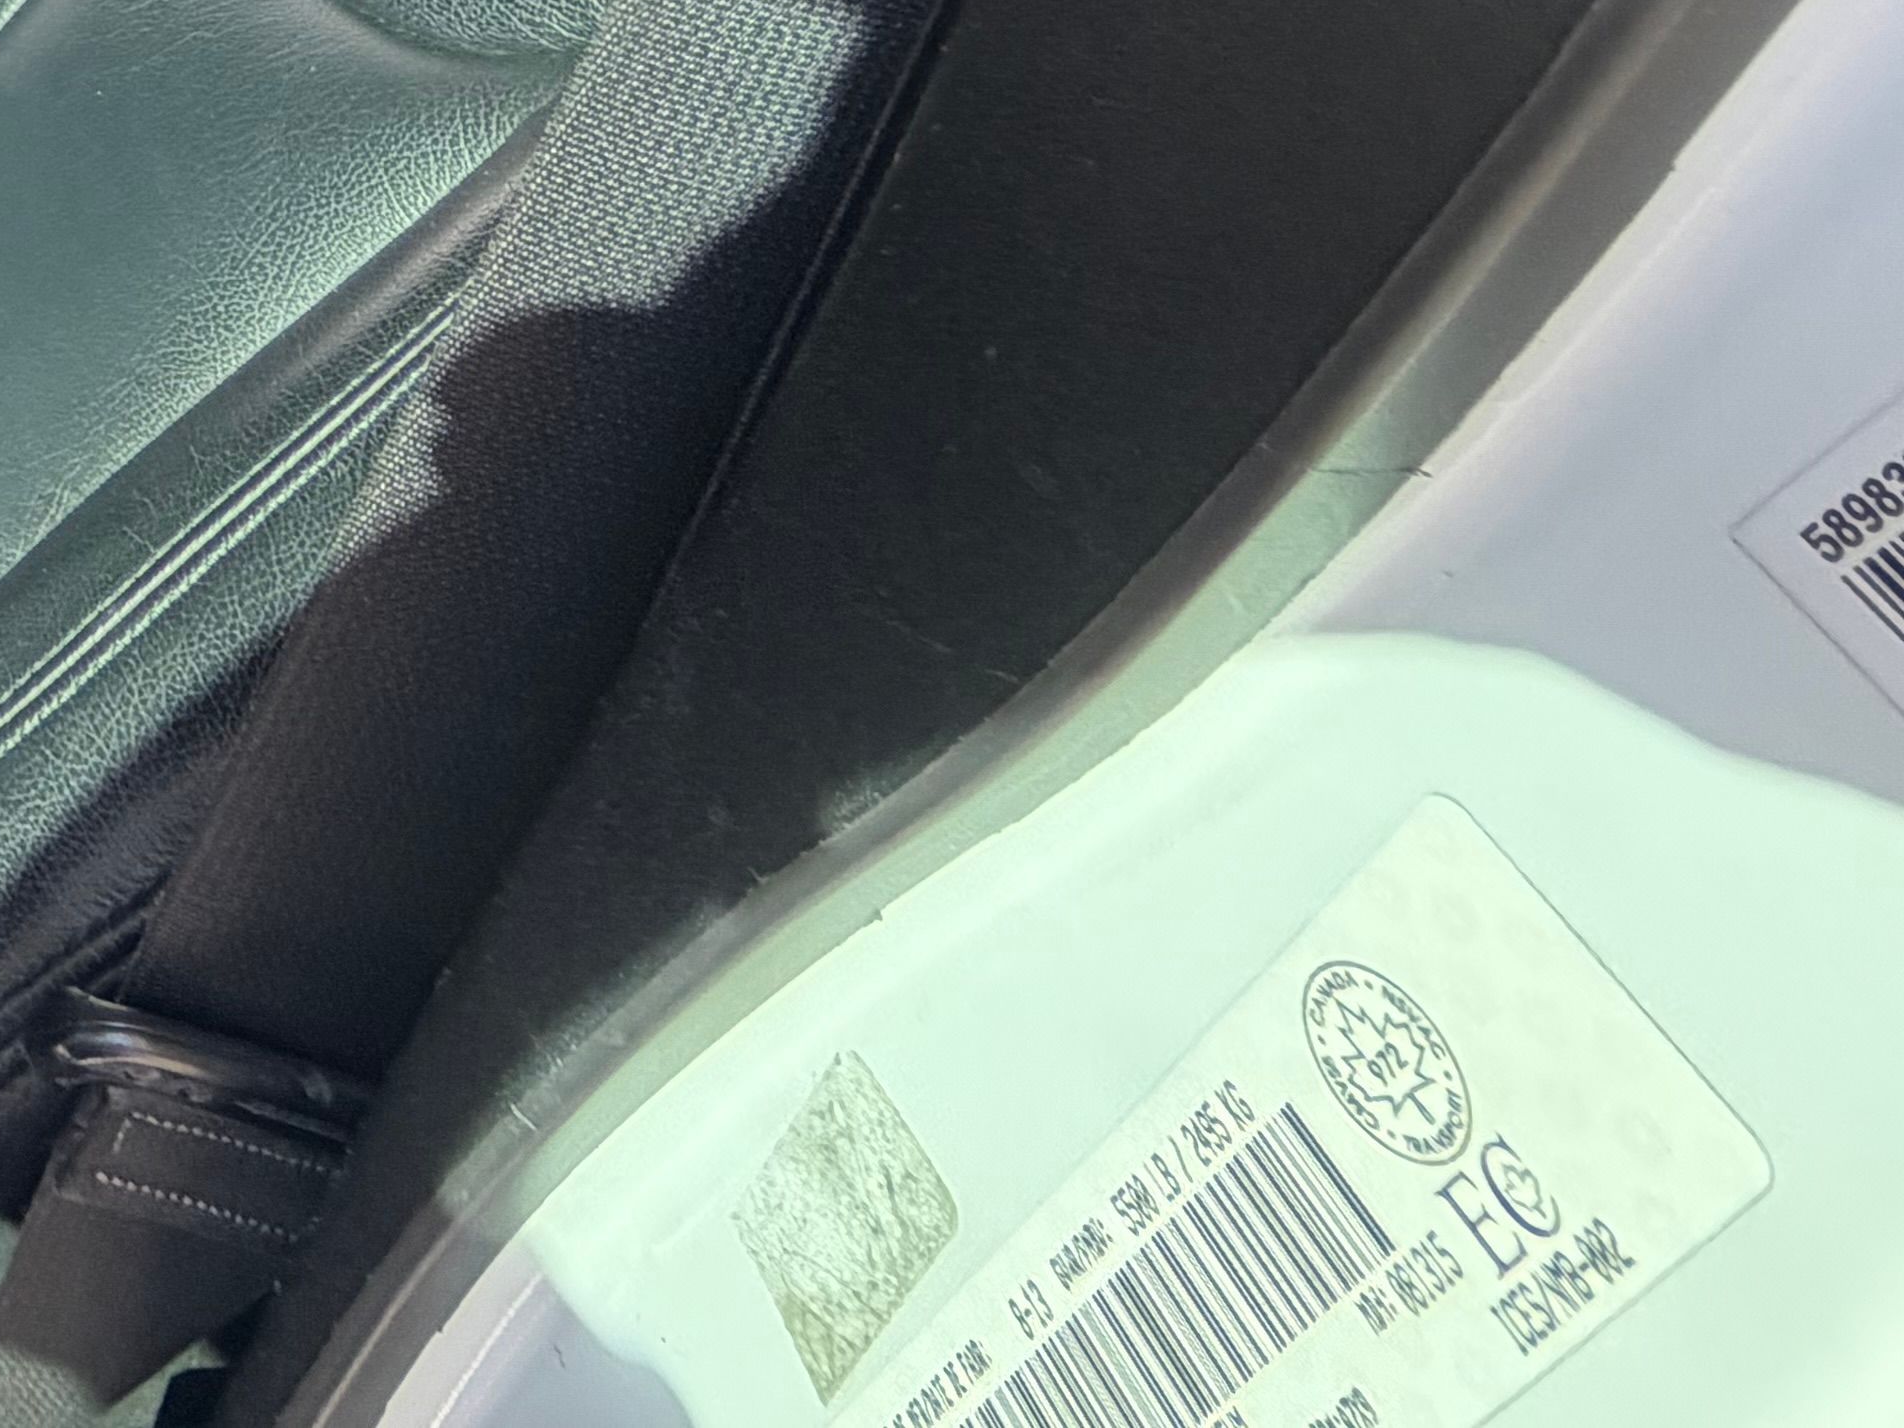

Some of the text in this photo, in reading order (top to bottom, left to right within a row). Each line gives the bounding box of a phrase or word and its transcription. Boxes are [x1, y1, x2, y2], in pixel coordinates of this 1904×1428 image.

[1309, 970, 1360, 1027] CANADA
[1366, 1041, 1410, 1087] 972
[1402, 1087, 1464, 1154] TRANSPORT
[1008, 1278, 1054, 1340] 8-13
[1109, 1173, 1161, 1237] 5500
[1142, 1152, 1183, 1202] LB
[1179, 1100, 1233, 1168] 2495
[1214, 1079, 1256, 1132] KG
[1385, 1230, 1465, 1318] 081315
